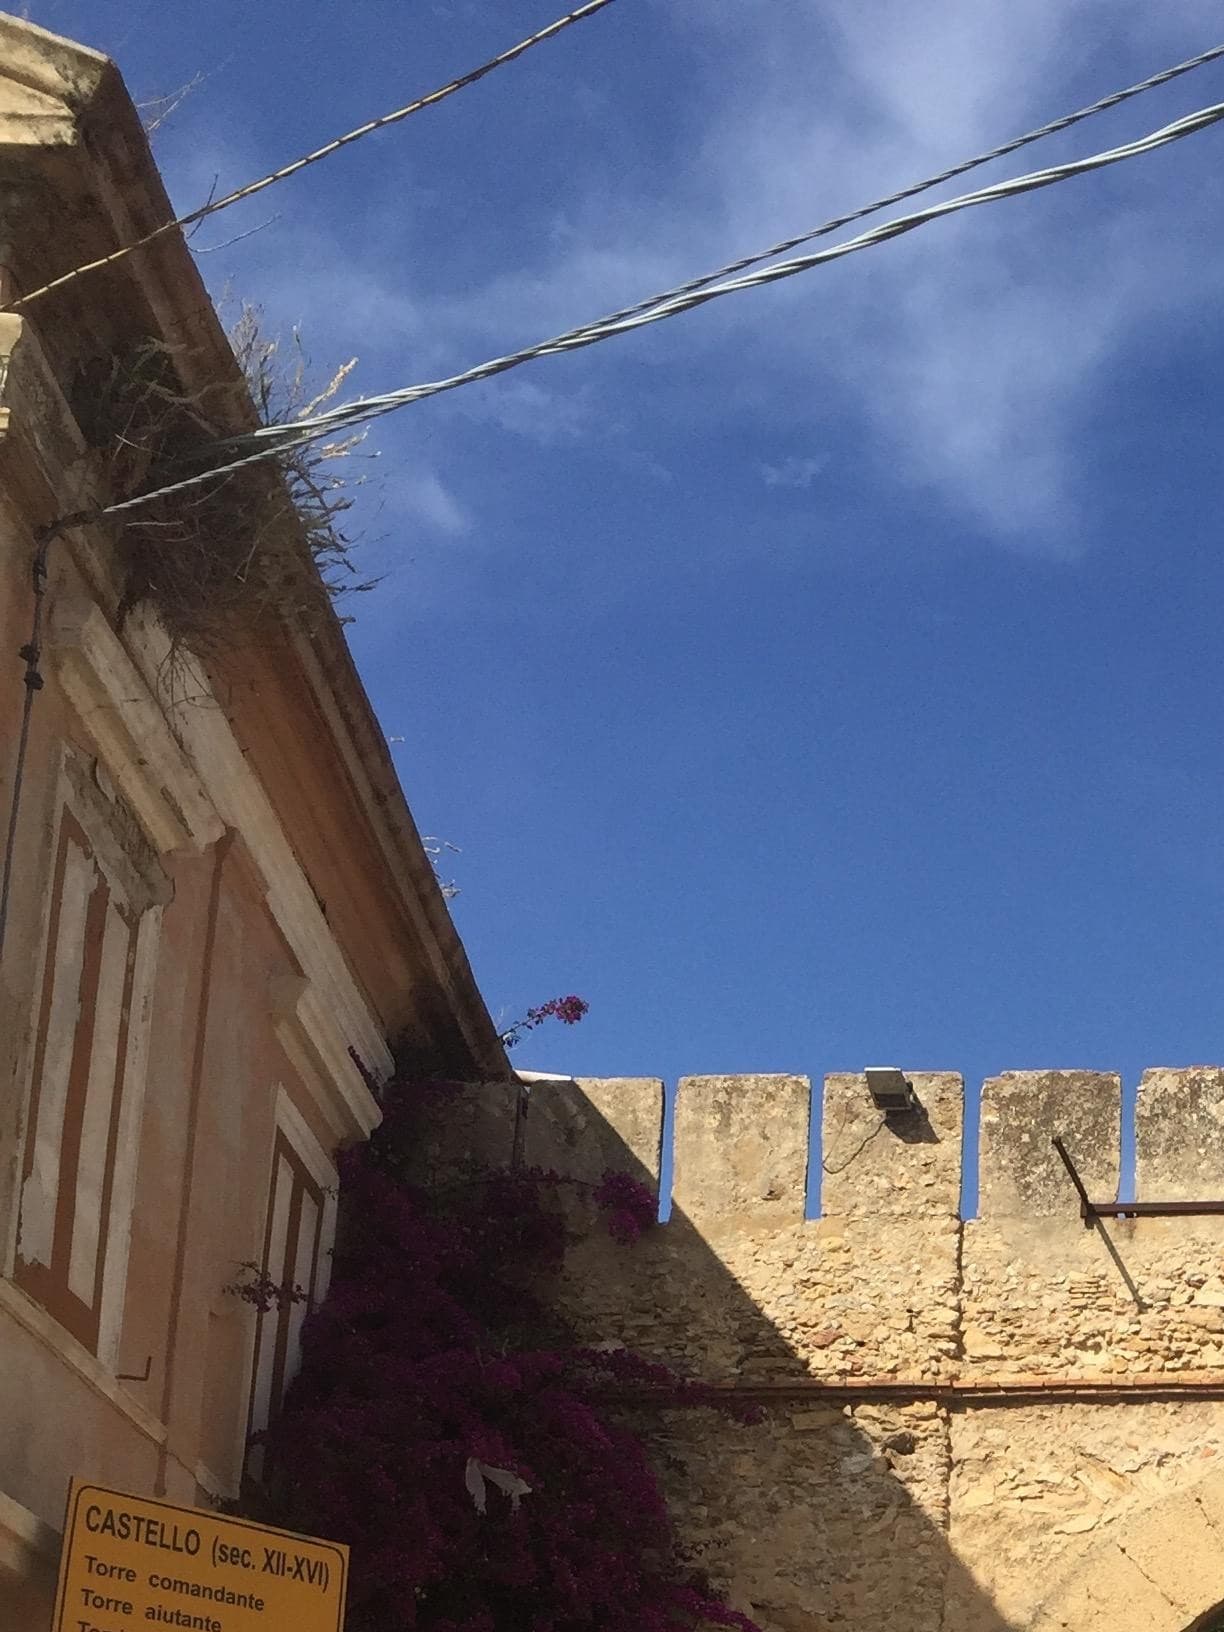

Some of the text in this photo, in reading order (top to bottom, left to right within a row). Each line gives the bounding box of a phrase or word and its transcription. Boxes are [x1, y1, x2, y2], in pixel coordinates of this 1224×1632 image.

[85, 1505, 329, 1593] CASTELLO (sec. XII-XVI)
[81, 1588, 133, 1616] Torre
[84, 1555, 265, 1612] Torre comandante
